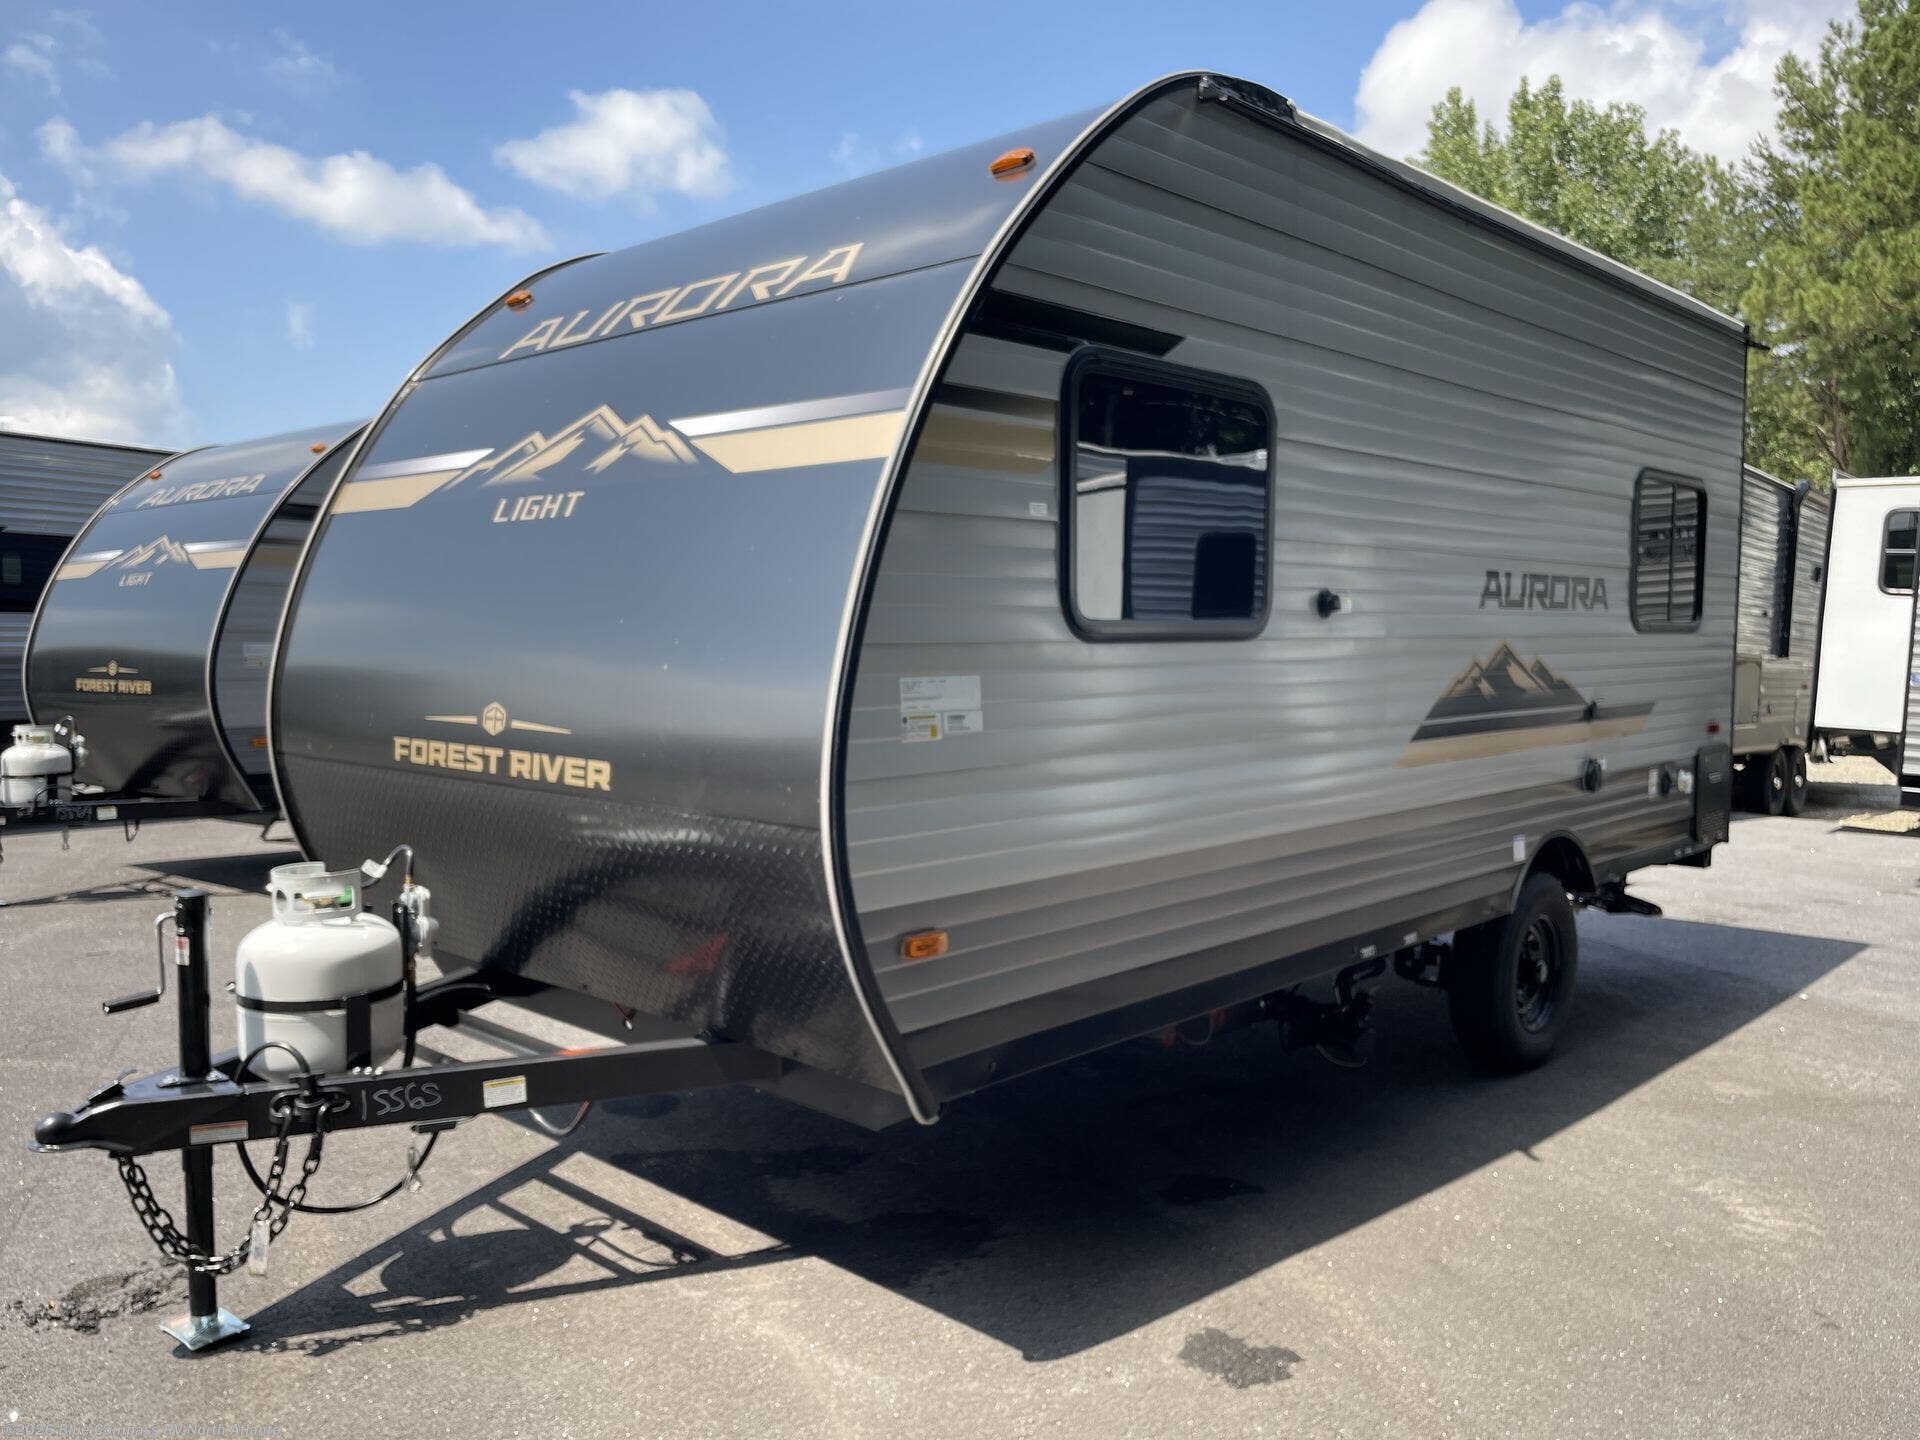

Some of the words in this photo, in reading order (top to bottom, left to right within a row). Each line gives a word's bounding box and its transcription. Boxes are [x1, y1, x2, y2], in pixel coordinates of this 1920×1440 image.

[498, 242, 865, 361] AURORA
[136, 473, 266, 510] AURORA
[491, 491, 586, 523] LIGHT
[118, 572, 153, 587] LIGHT
[1478, 570, 1609, 610] AURORA
[75, 677, 117, 693] FOREST
[118, 679, 152, 695] RIVER
[393, 735, 504, 775] FOREST
[509, 749, 612, 792] RIVER
